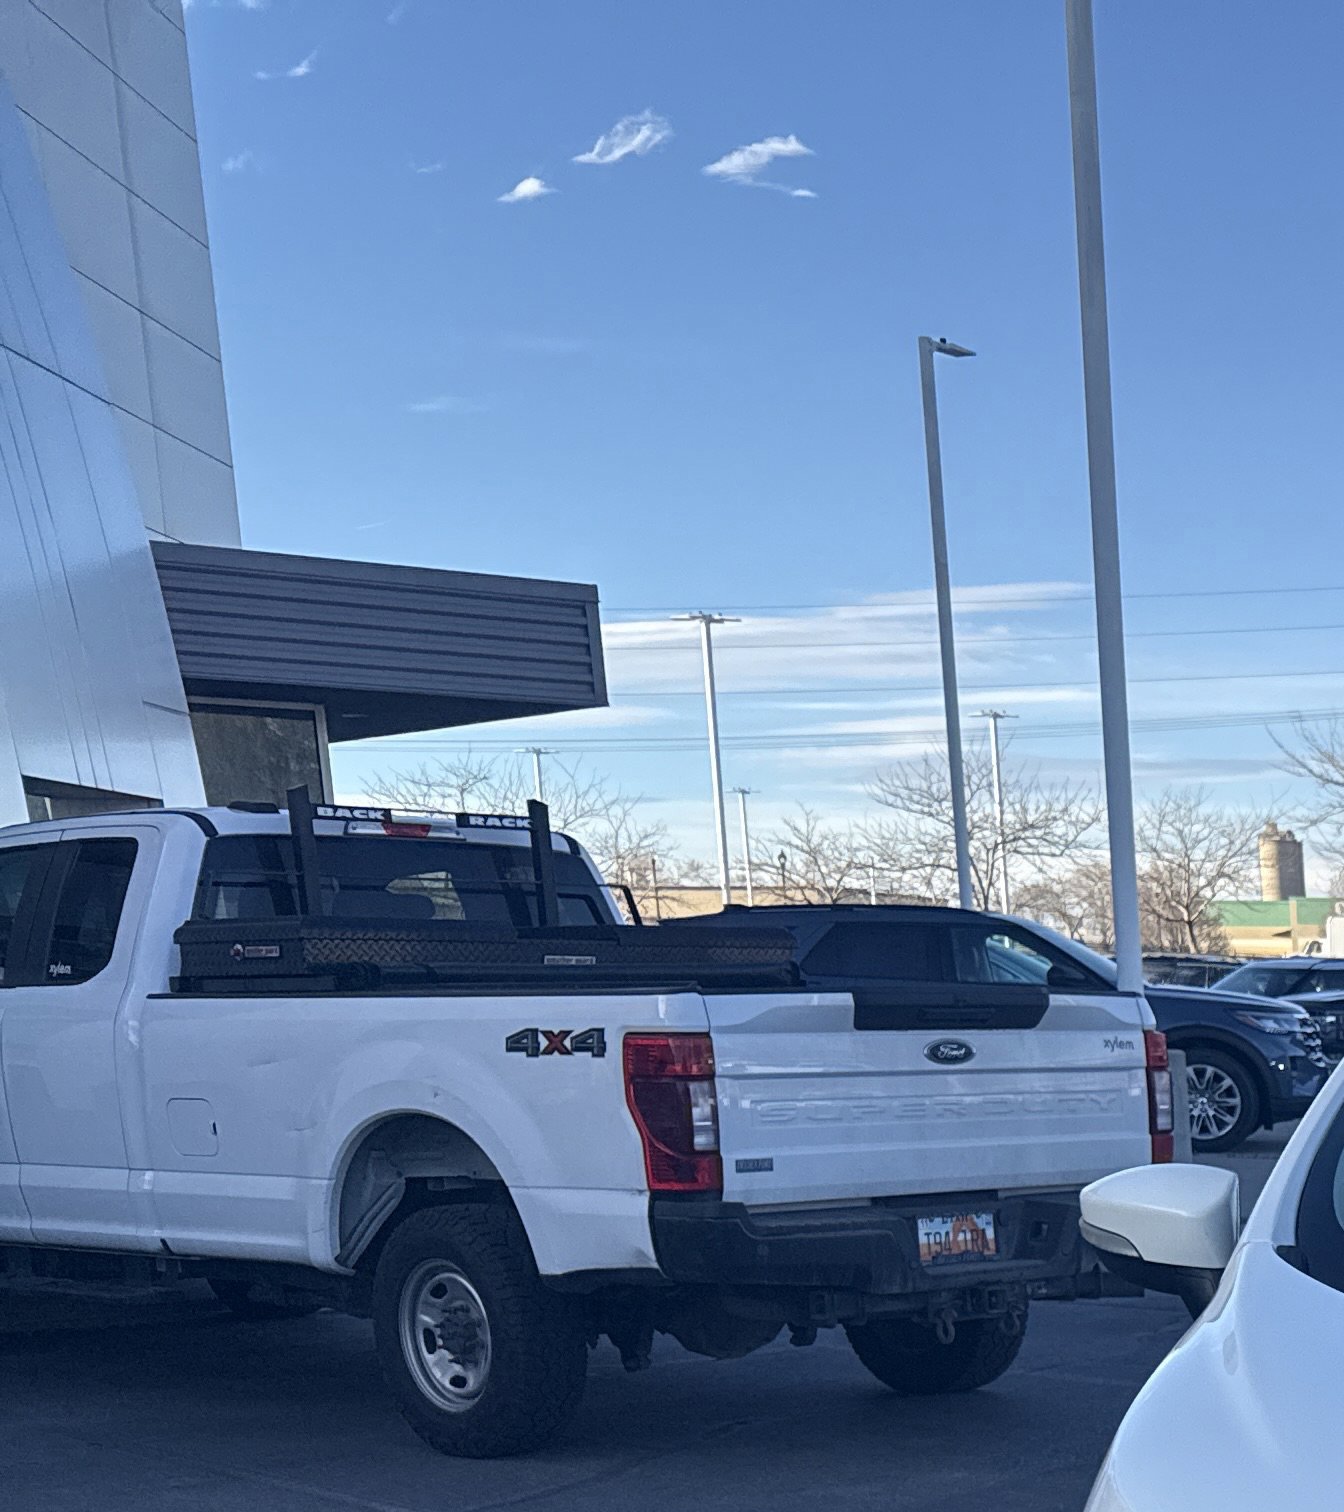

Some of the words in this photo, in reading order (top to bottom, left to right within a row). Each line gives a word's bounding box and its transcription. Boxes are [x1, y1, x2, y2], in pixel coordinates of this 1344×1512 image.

[316, 806, 385, 820] BACK
[468, 815, 533, 828] RACK
[937, 1044, 966, 1058] Ford
[1103, 1035, 1135, 1052] xylem
[759, 1096, 967, 1123] SUPER
[981, 1092, 1118, 1116] DUTY
